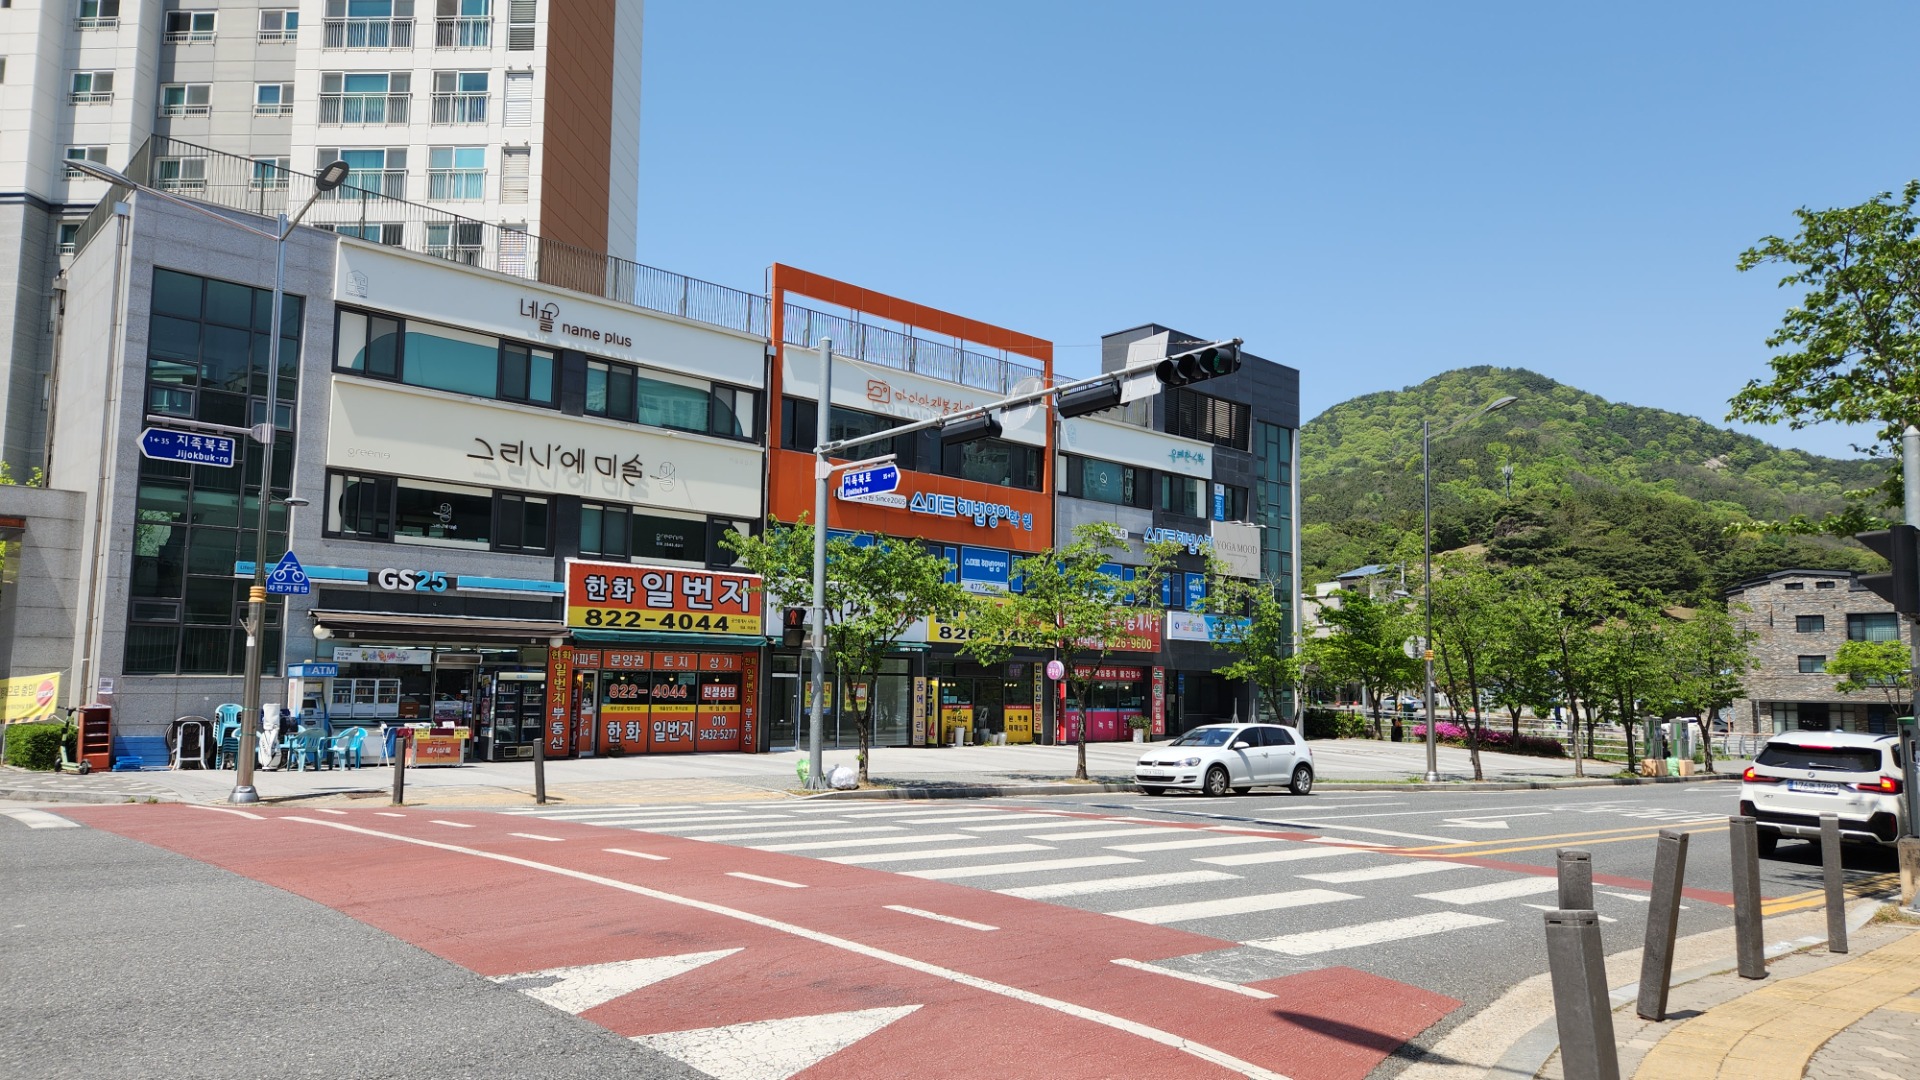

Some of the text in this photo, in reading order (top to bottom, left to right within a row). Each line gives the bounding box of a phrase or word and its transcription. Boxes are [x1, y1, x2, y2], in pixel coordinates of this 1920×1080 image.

[562, 323, 600, 340] name
[604, 332, 632, 347] plus
[176, 435, 229, 452] 지족북로
[176, 450, 228, 463] Jijokbuk-ro
[595, 454, 643, 486] 미술
[845, 472, 872, 486] 지족북로
[910, 491, 957, 518] 스마트
[957, 496, 1010, 528] 해법영어
[268, 585, 308, 593] 자전거횡단
[378, 568, 448, 592] GS25
[584, 572, 750, 613] 한화 일번지
[585, 609, 730, 632] 822-4044
[552, 650, 571, 660] 한화
[312, 666, 335, 675] ATM
[552, 663, 567, 705] 일번지
[551, 708, 565, 750] 부동산
[606, 721, 641, 743] 한화
[653, 720, 694, 742] 일번지
[712, 716, 726, 727] 010
[700, 729, 737, 740] 3432-5277
